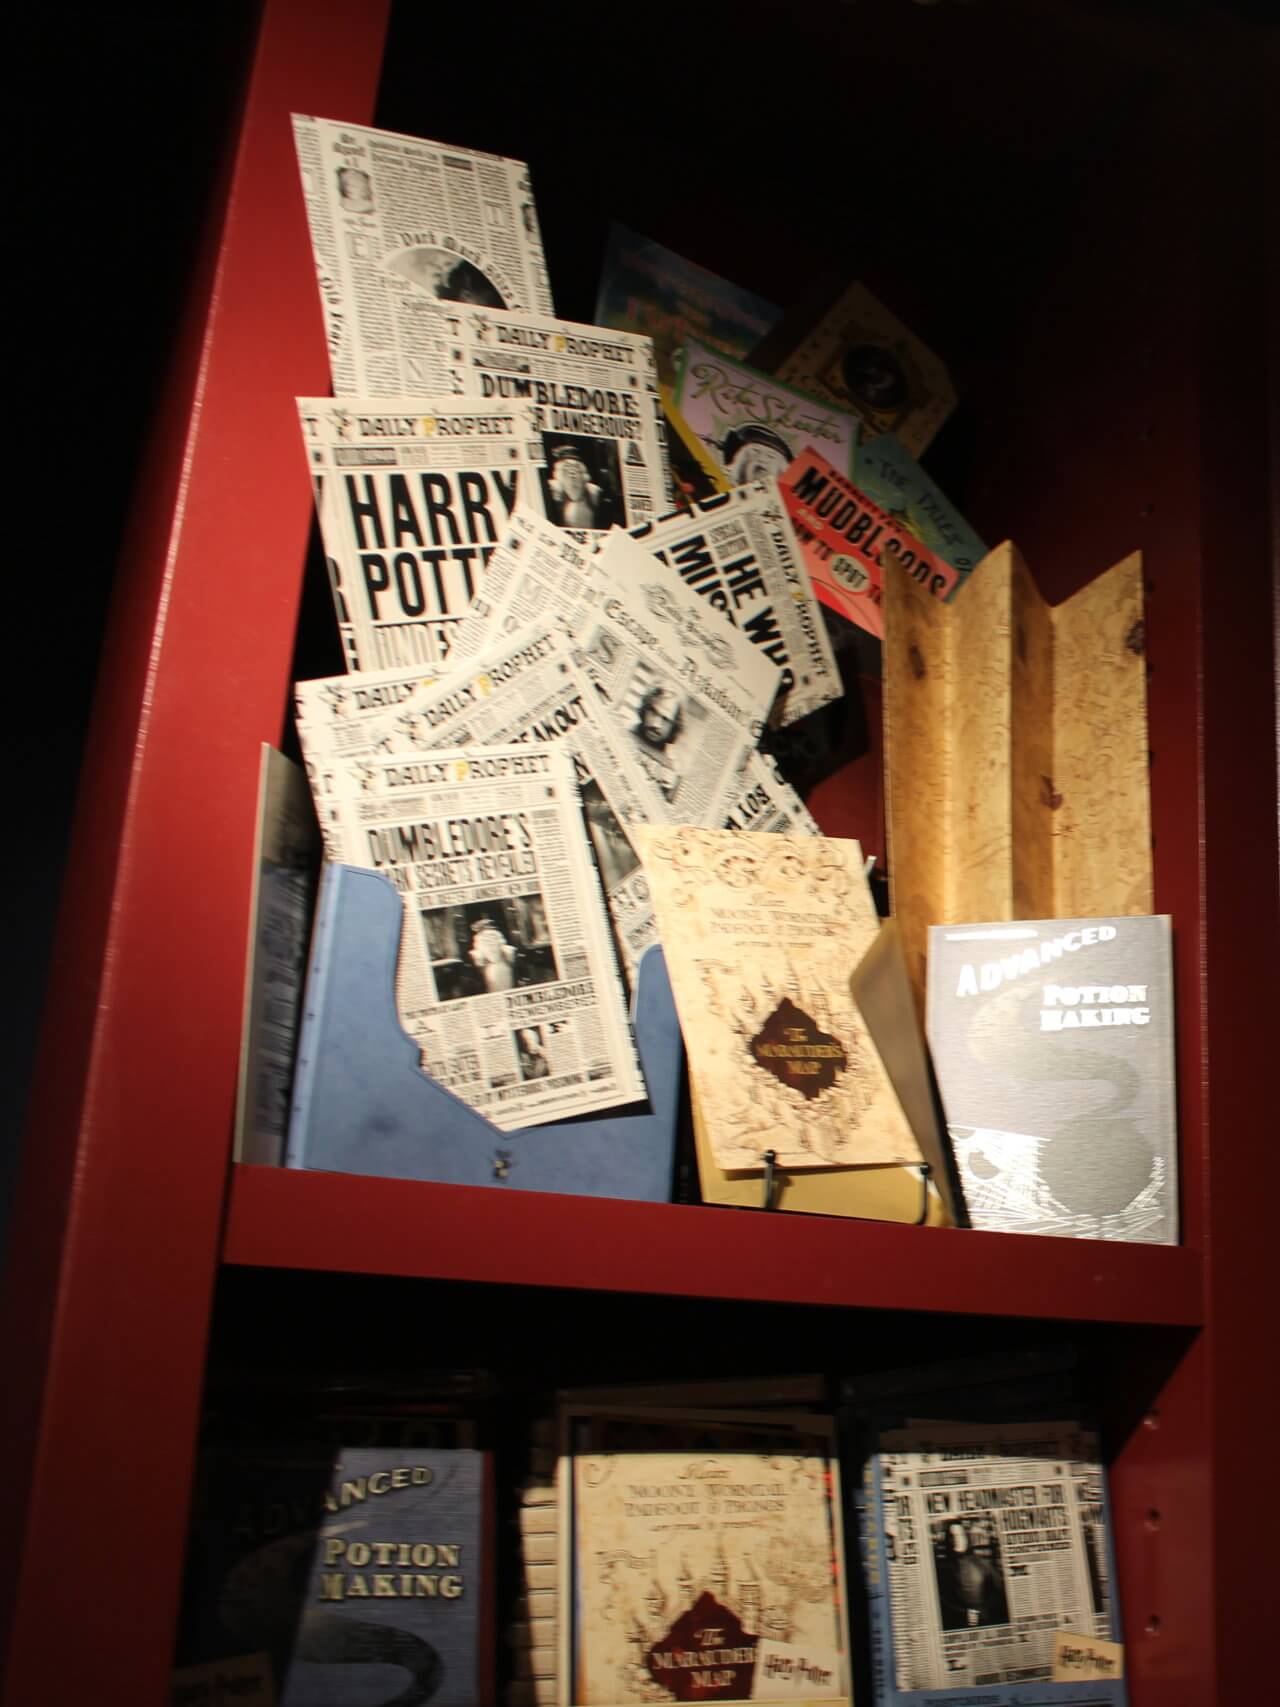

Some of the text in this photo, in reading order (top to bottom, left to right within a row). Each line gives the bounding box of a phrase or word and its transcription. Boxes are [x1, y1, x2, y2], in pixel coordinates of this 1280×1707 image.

[496, 324, 635, 365] DAILY PROPHET
[357, 416, 514, 438] DAILY PROPHET
[343, 469, 518, 550] HARRY
[771, 530, 831, 678] DAILY PROPHET
[354, 681, 418, 709] DAILY
[422, 683, 478, 728] DAILY
[475, 633, 559, 698] PROPHET
[383, 753, 551, 787] DAILY PROPHET
[956, 926, 1117, 997] ADVANCED
[1042, 984, 1148, 1006] POTION
[1039, 1007, 1150, 1031] MAKING
[322, 1538, 461, 1568] POTION
[319, 1572, 464, 1602] MAKING
